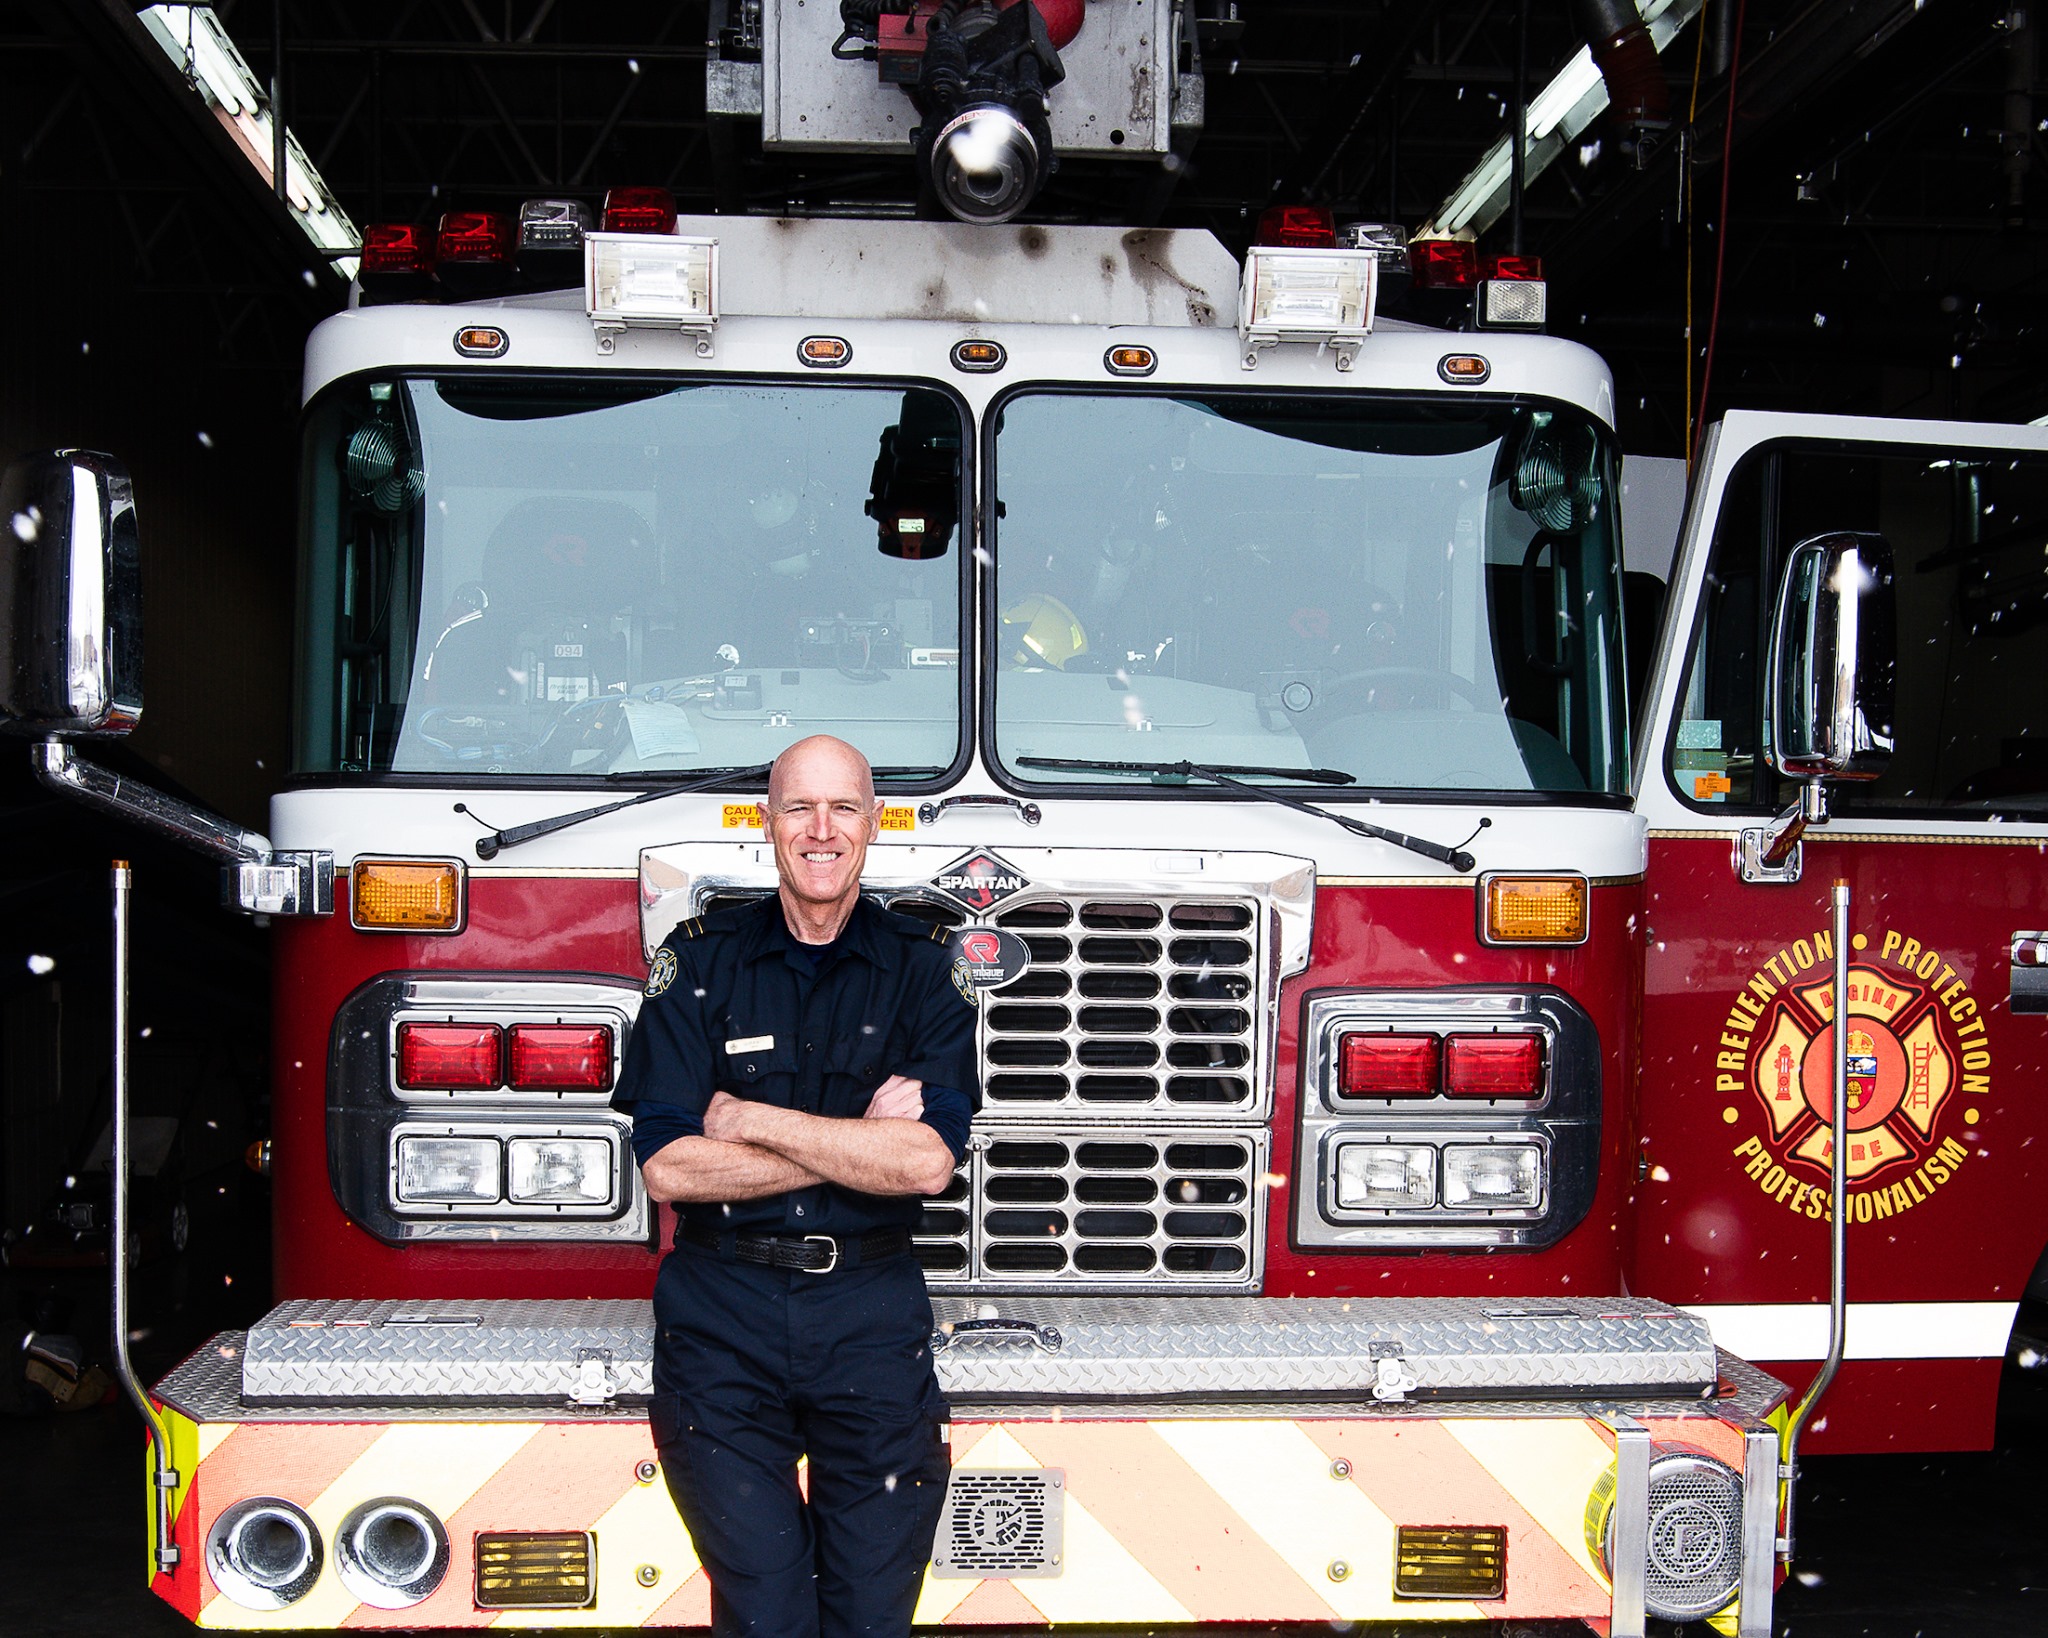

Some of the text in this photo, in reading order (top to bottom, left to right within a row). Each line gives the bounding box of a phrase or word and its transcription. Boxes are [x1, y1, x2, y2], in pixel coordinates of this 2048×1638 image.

[556, 645, 581, 657] 094
[724, 806, 913, 818] CAUT HEN
[938, 875, 1022, 890] SPARTAN
[972, 964, 1005, 978] enbauer
[1820, 984, 1898, 1011] RGINA
[1717, 929, 1834, 1092] PREVENTION
[1880, 929, 1991, 1093] PROTECTION
[1822, 1139, 1883, 1161] FRE
